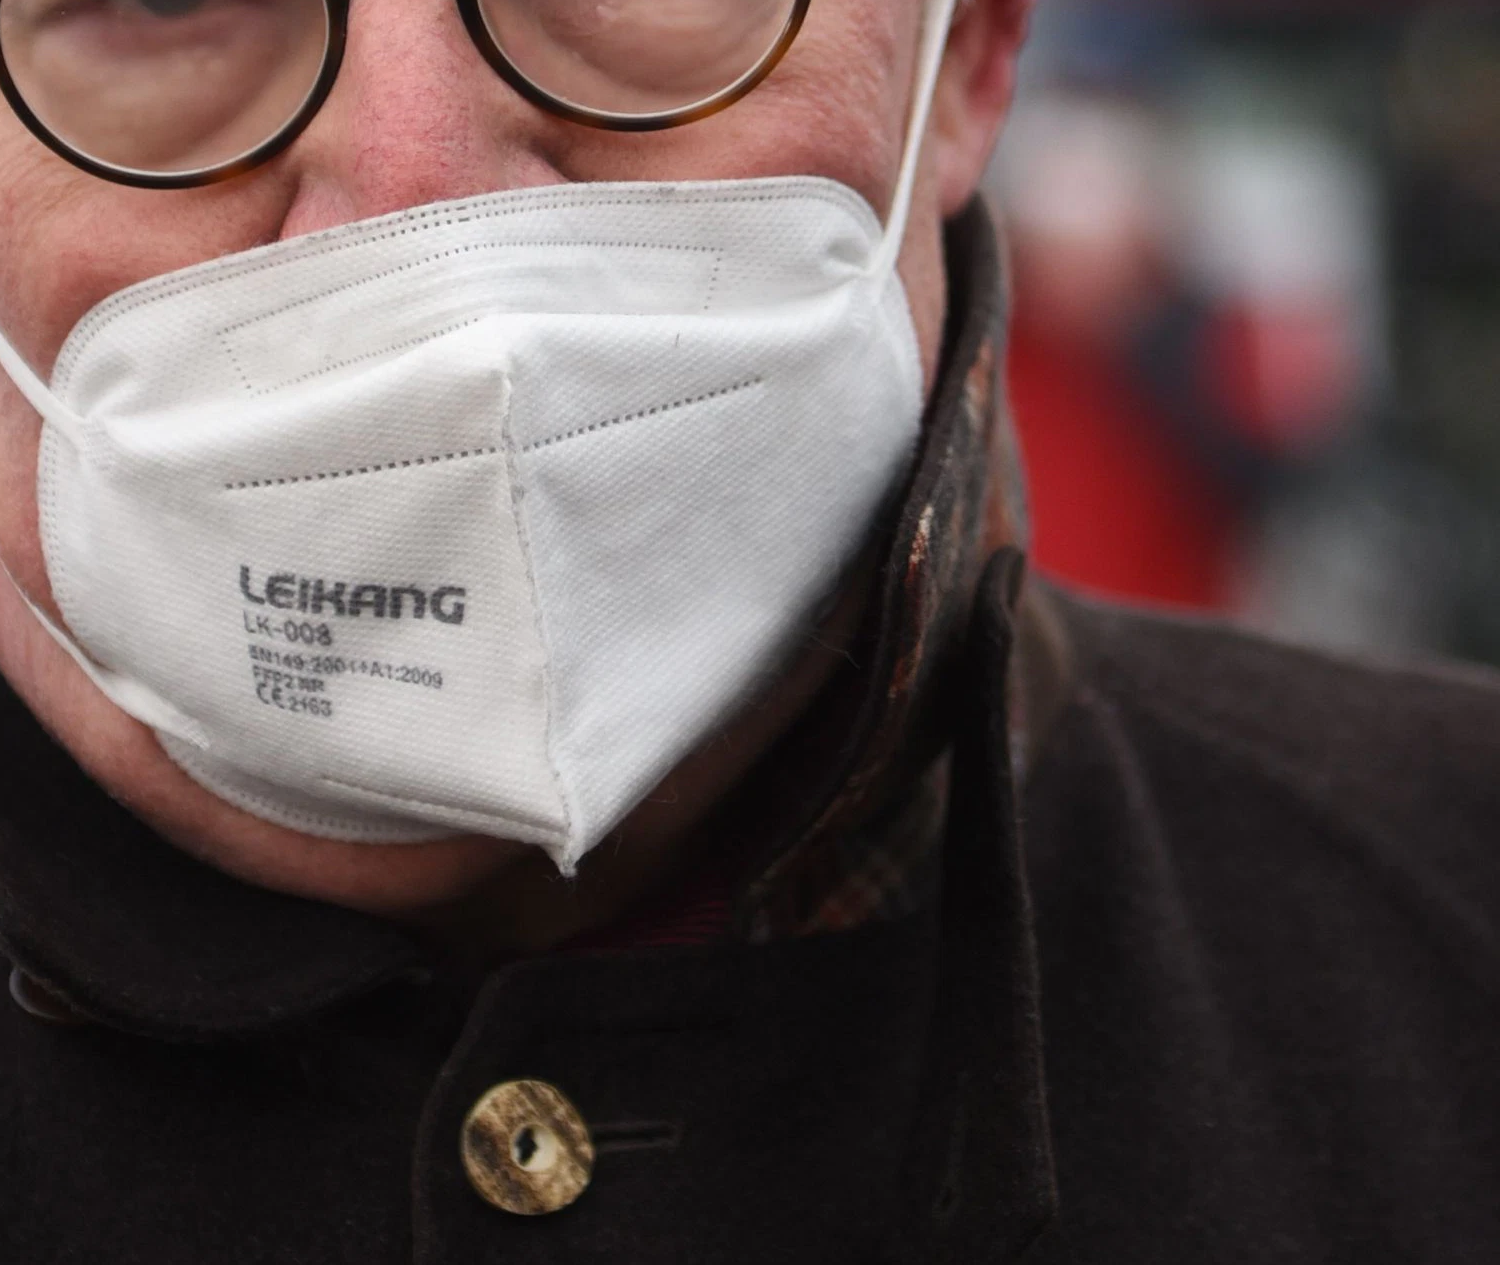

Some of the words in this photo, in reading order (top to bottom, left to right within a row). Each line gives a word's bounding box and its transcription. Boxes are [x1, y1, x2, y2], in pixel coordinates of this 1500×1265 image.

[240, 565, 466, 625] LEIKANG
[243, 610, 333, 646] LK-008
[252, 665, 294, 689] FFP2
